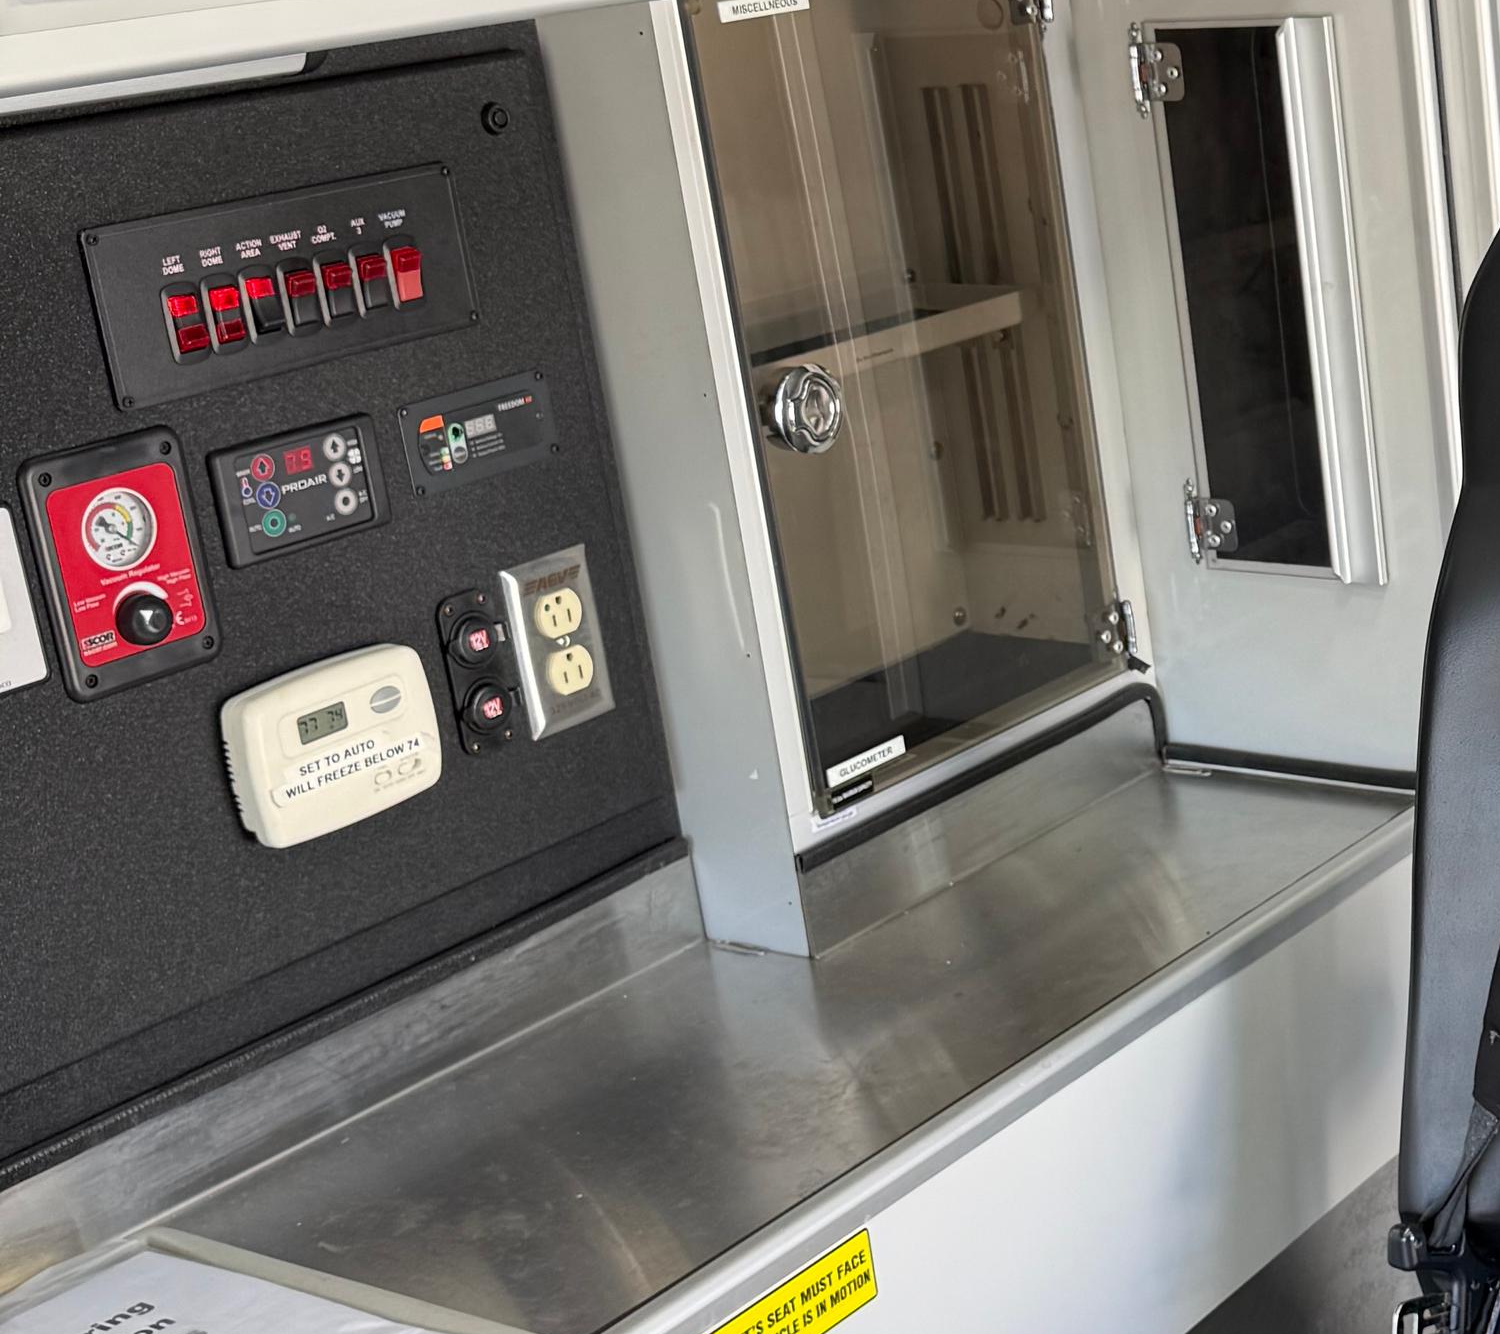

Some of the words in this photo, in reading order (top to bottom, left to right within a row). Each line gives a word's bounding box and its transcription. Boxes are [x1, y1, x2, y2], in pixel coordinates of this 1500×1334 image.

[350, 217, 365, 228] AUX
[378, 209, 406, 222] VACUUM
[384, 219, 403, 229] PUMP
[269, 229, 302, 245] EXHAUST
[199, 246, 222, 259] RIGHT
[236, 238, 262, 252] ACTION
[278, 240, 298, 252] VENT
[162, 254, 181, 267] LEFT
[201, 255, 224, 268] DOME
[240, 248, 261, 260] AREA
[162, 263, 185, 276] DOME
[281, 473, 327, 495] PROAIR
[470, 629, 489, 652] 12V
[483, 697, 503, 720] 12V
[300, 717, 318, 734] 77
[328, 708, 344, 723] 74
[299, 759, 321, 777] SET
[325, 752, 340, 767] TO
[344, 739, 376, 760] AUTO
[838, 745, 894, 778] GLUCOMETER
[285, 779, 315, 800] WILL
[318, 760, 362, 788] FREEZE
[364, 743, 405, 768] BELOW
[407, 737, 420, 751] 74
[767, 1296, 797, 1329] SEAT
[800, 1272, 833, 1306] MUST
[836, 1249, 867, 1283] FACE
[802, 1309, 814, 1328] IS
[816, 1298, 827, 1318] IN
[829, 1268, 872, 1309] MOTION
